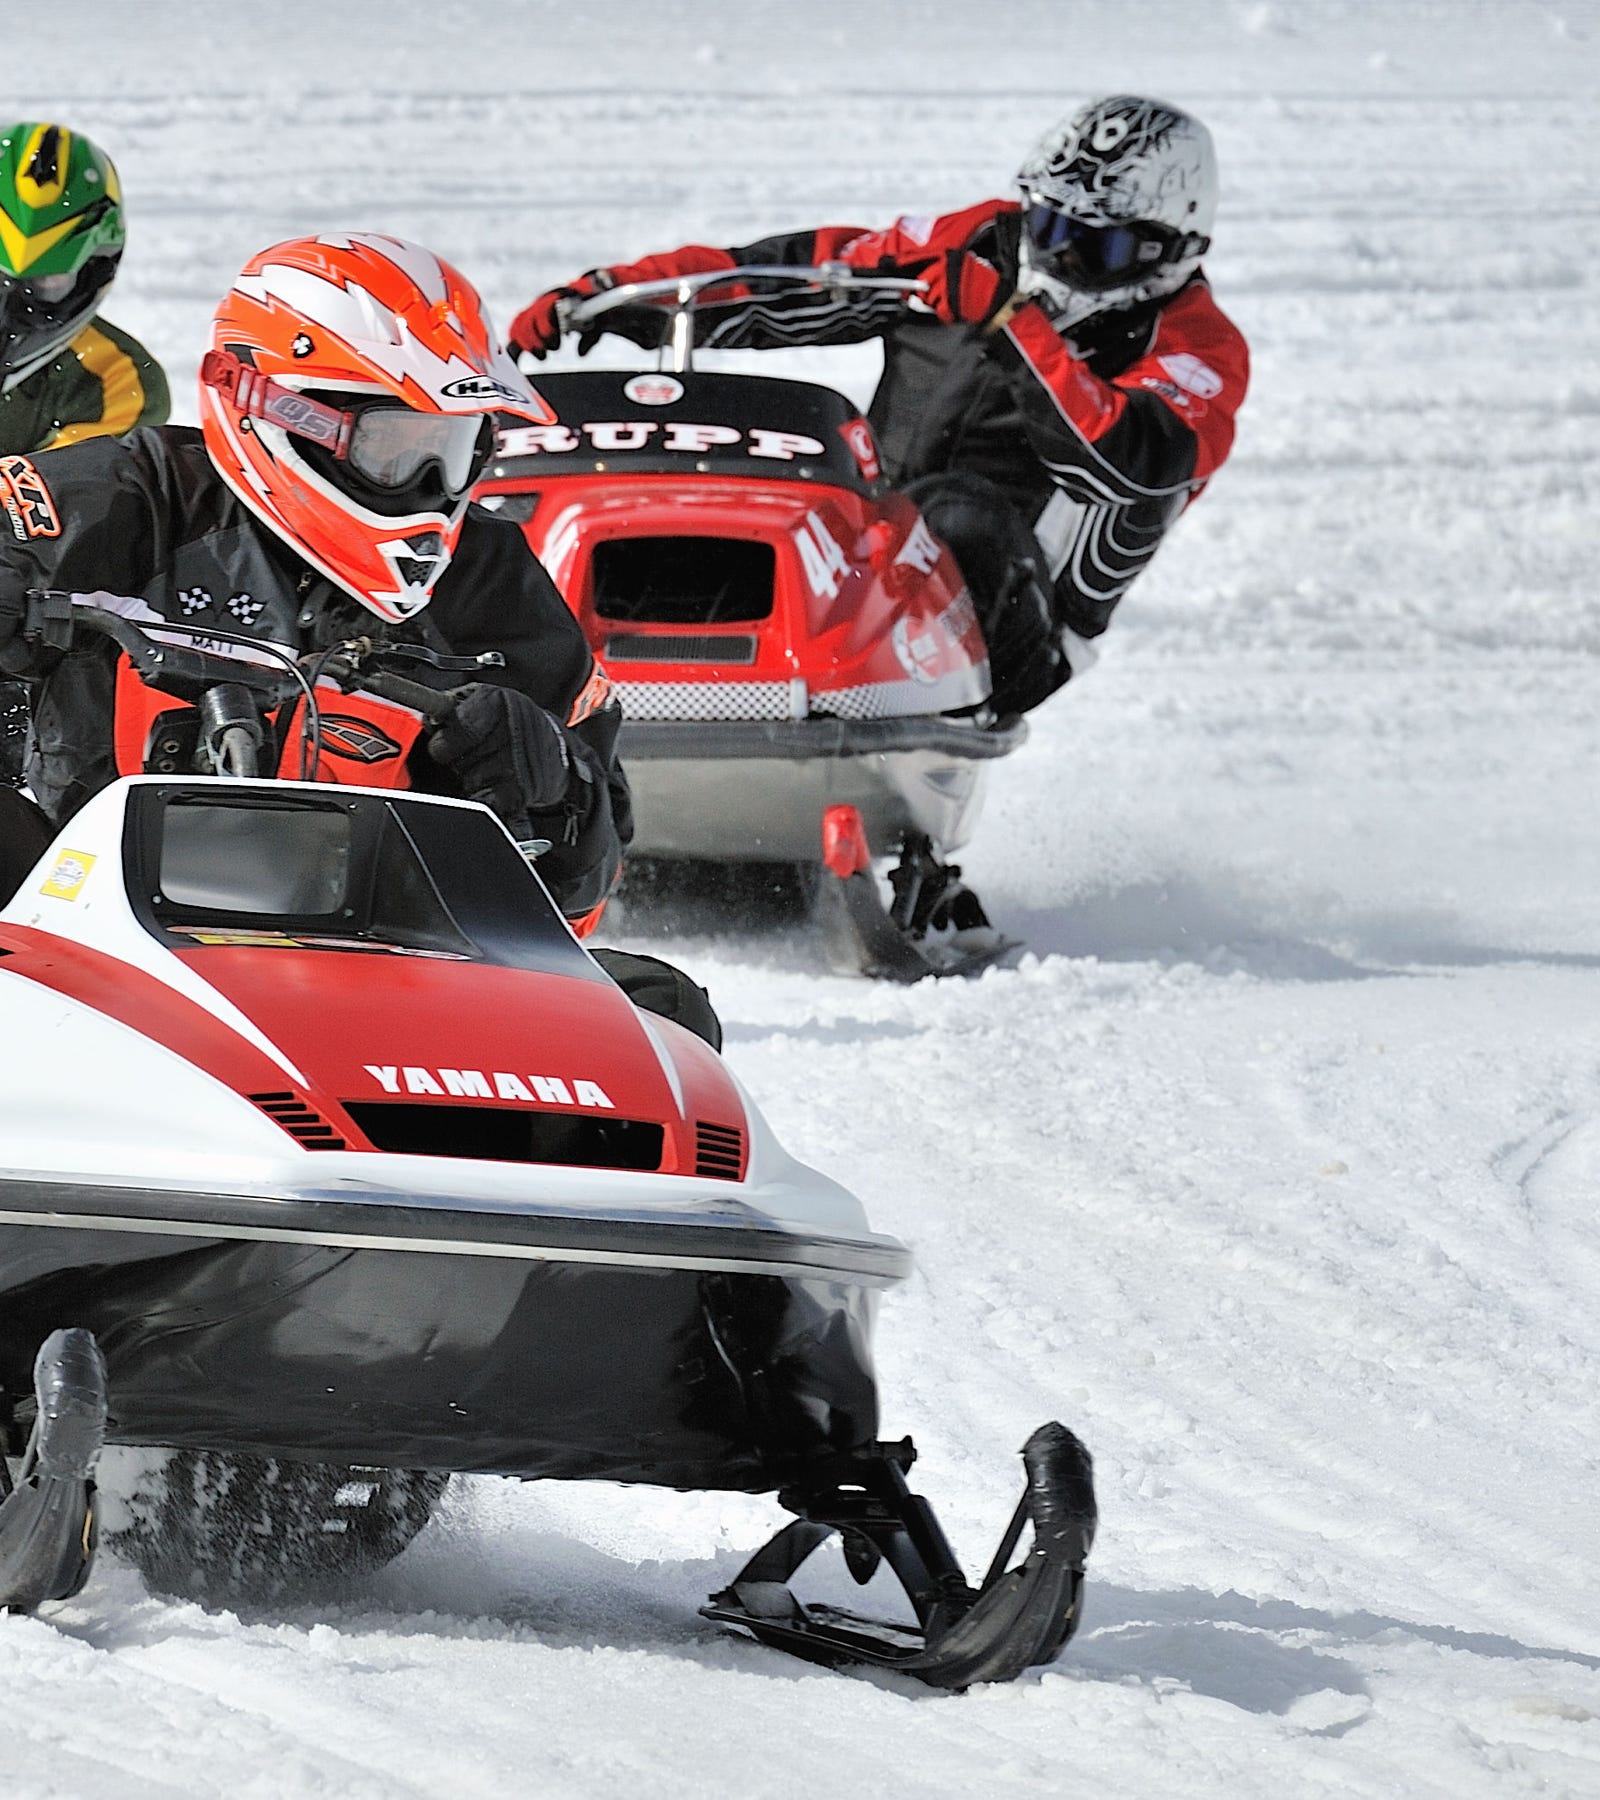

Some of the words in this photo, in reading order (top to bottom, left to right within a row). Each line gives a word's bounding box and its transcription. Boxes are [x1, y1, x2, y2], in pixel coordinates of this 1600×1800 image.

[496, 421, 826, 461] RUPP
[794, 510, 851, 599] 44
[362, 1064, 616, 1109] YAMAHA
